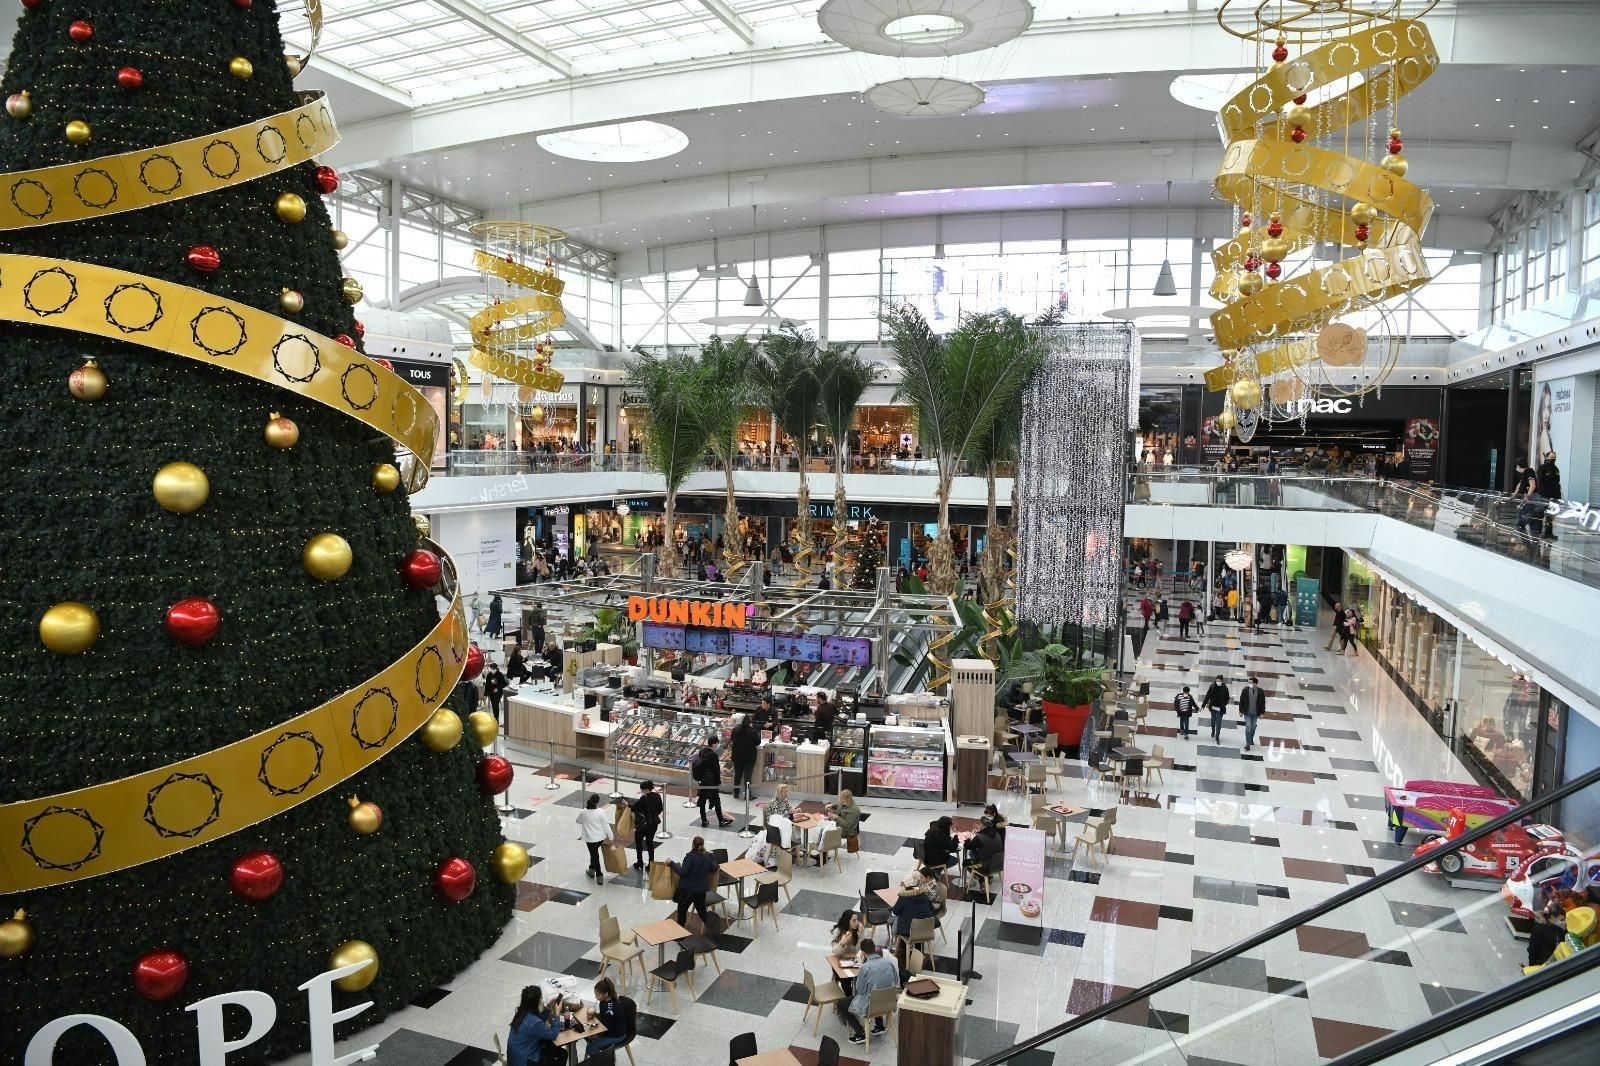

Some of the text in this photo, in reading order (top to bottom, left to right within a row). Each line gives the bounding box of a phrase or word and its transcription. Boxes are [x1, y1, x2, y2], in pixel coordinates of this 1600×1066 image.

[409, 369, 431, 379] TOUS
[797, 504, 873, 519] RIMRK
[1510, 858, 1517, 866] 5
